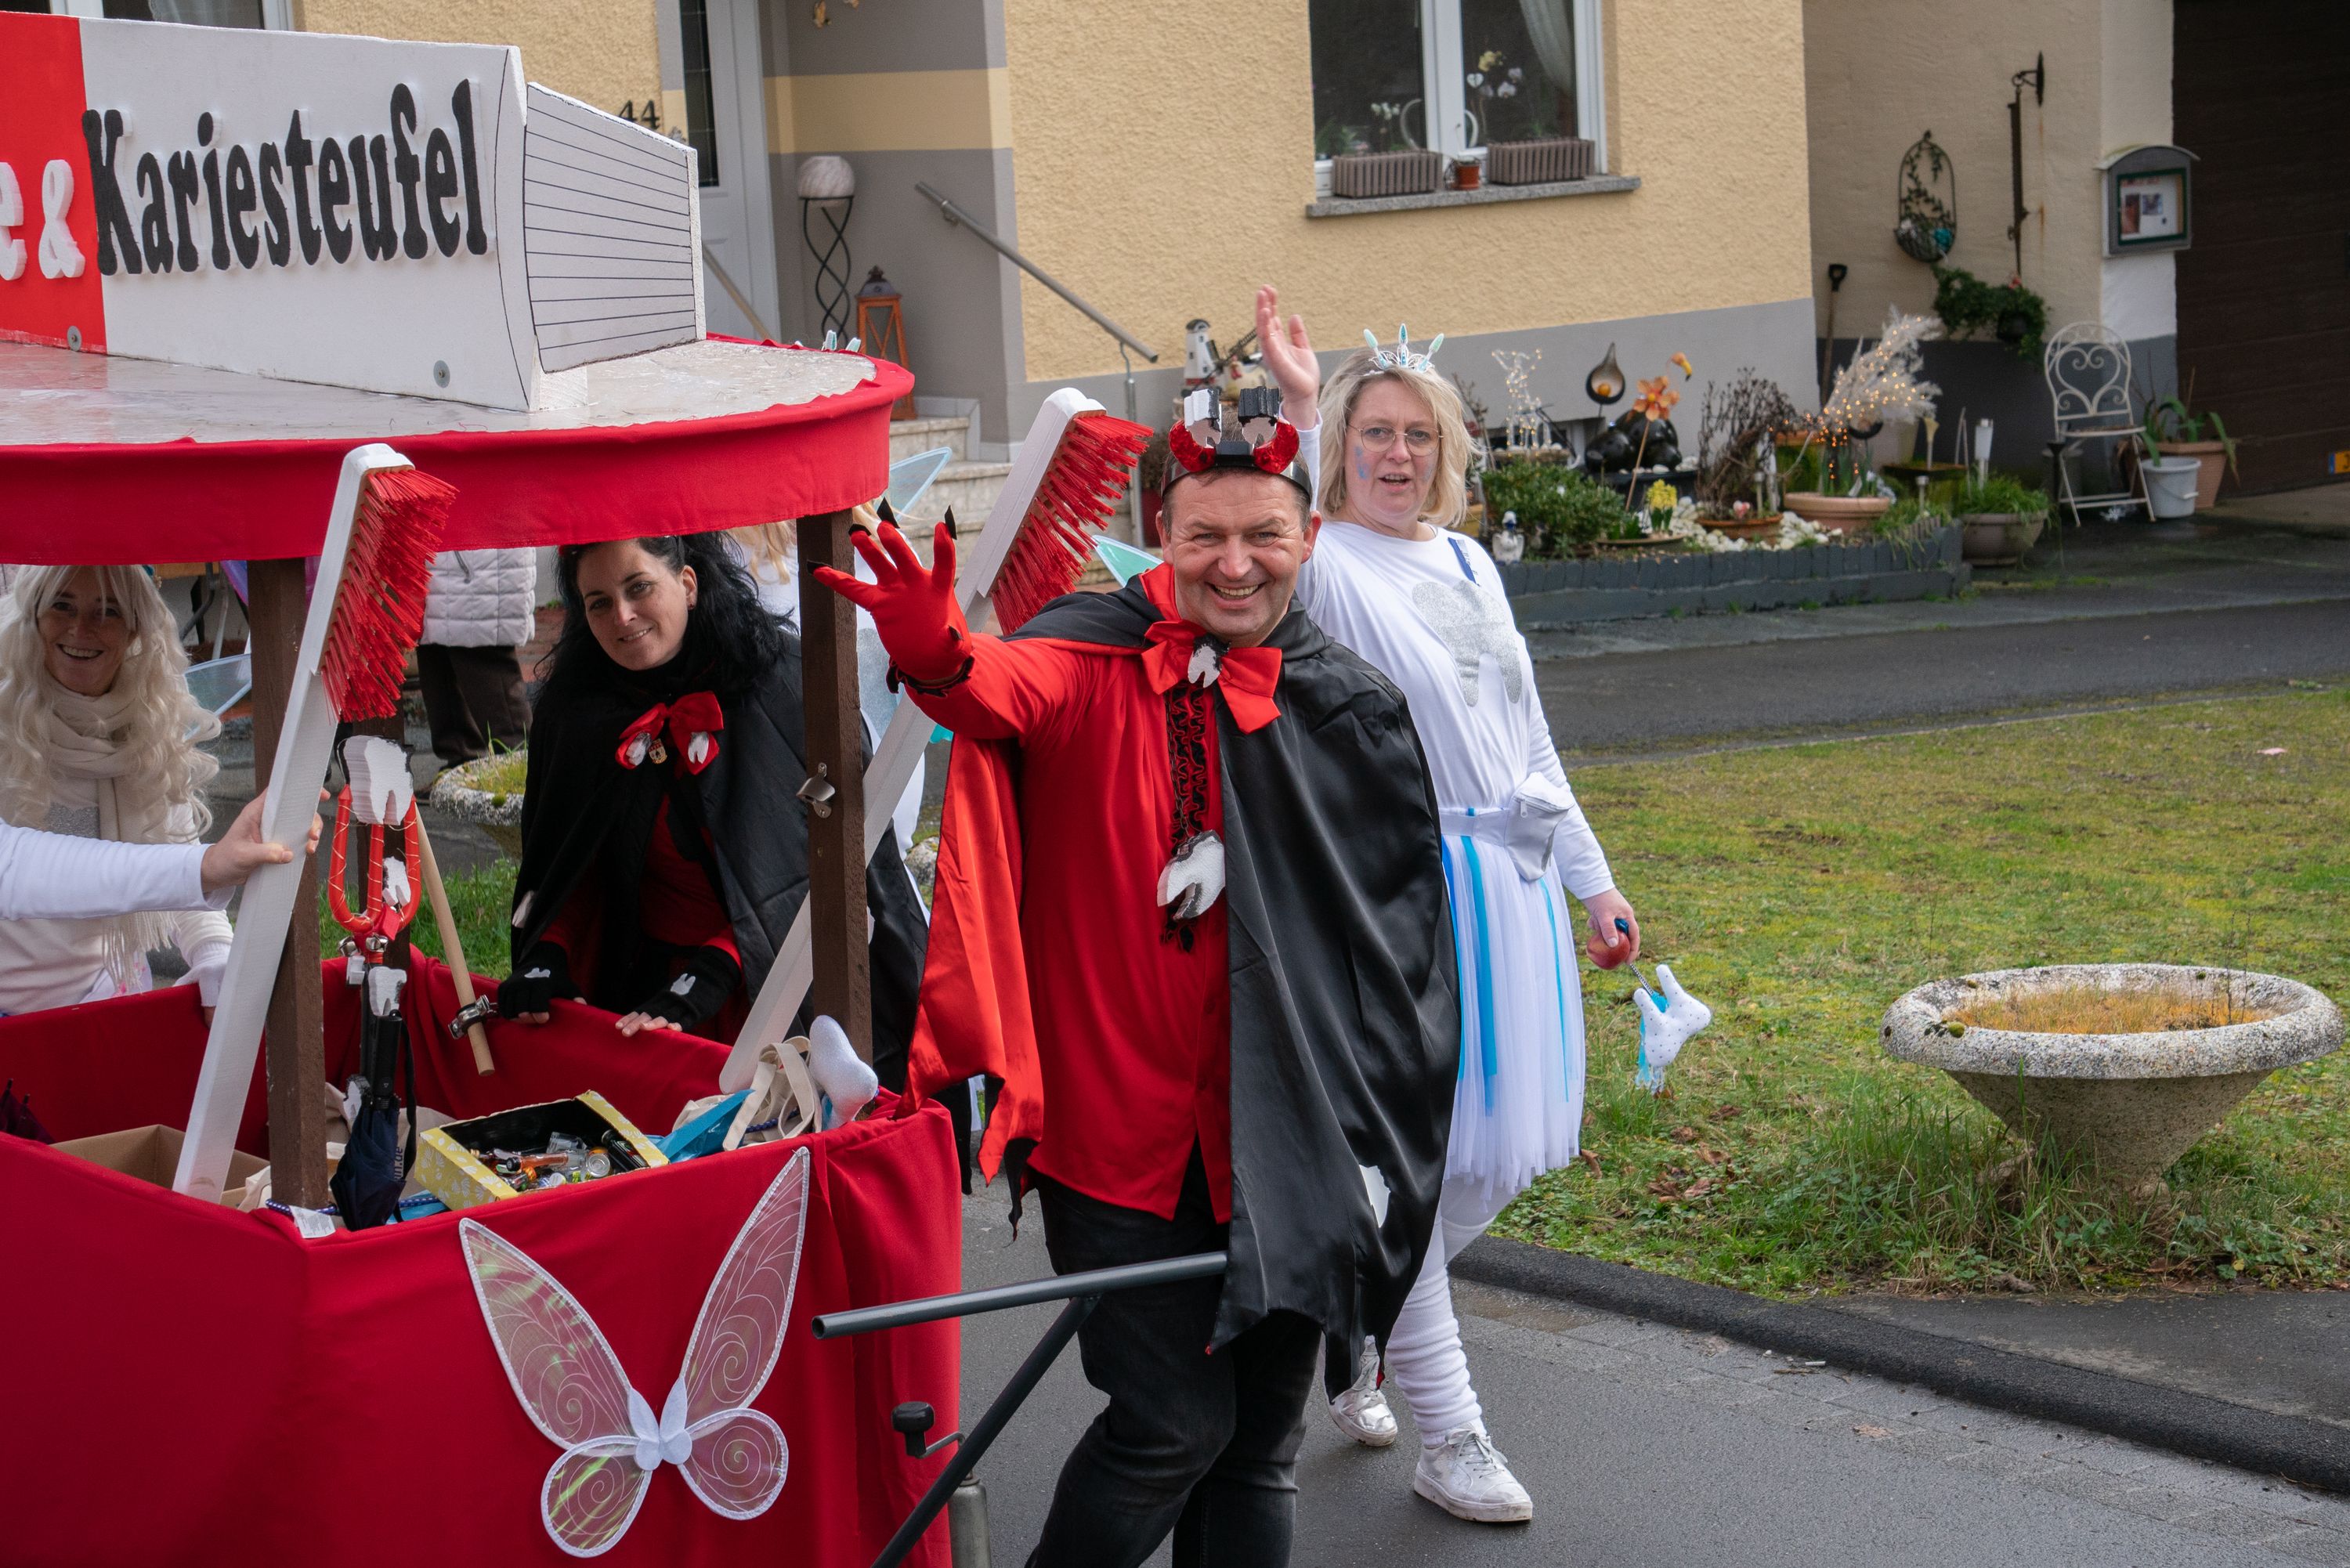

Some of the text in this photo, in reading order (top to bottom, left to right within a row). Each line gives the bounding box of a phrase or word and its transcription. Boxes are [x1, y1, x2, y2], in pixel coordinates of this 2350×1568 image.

[618, 99, 660, 129] 44
[38, 159, 85, 279] &
[81, 79, 490, 276] Kariesteufel
